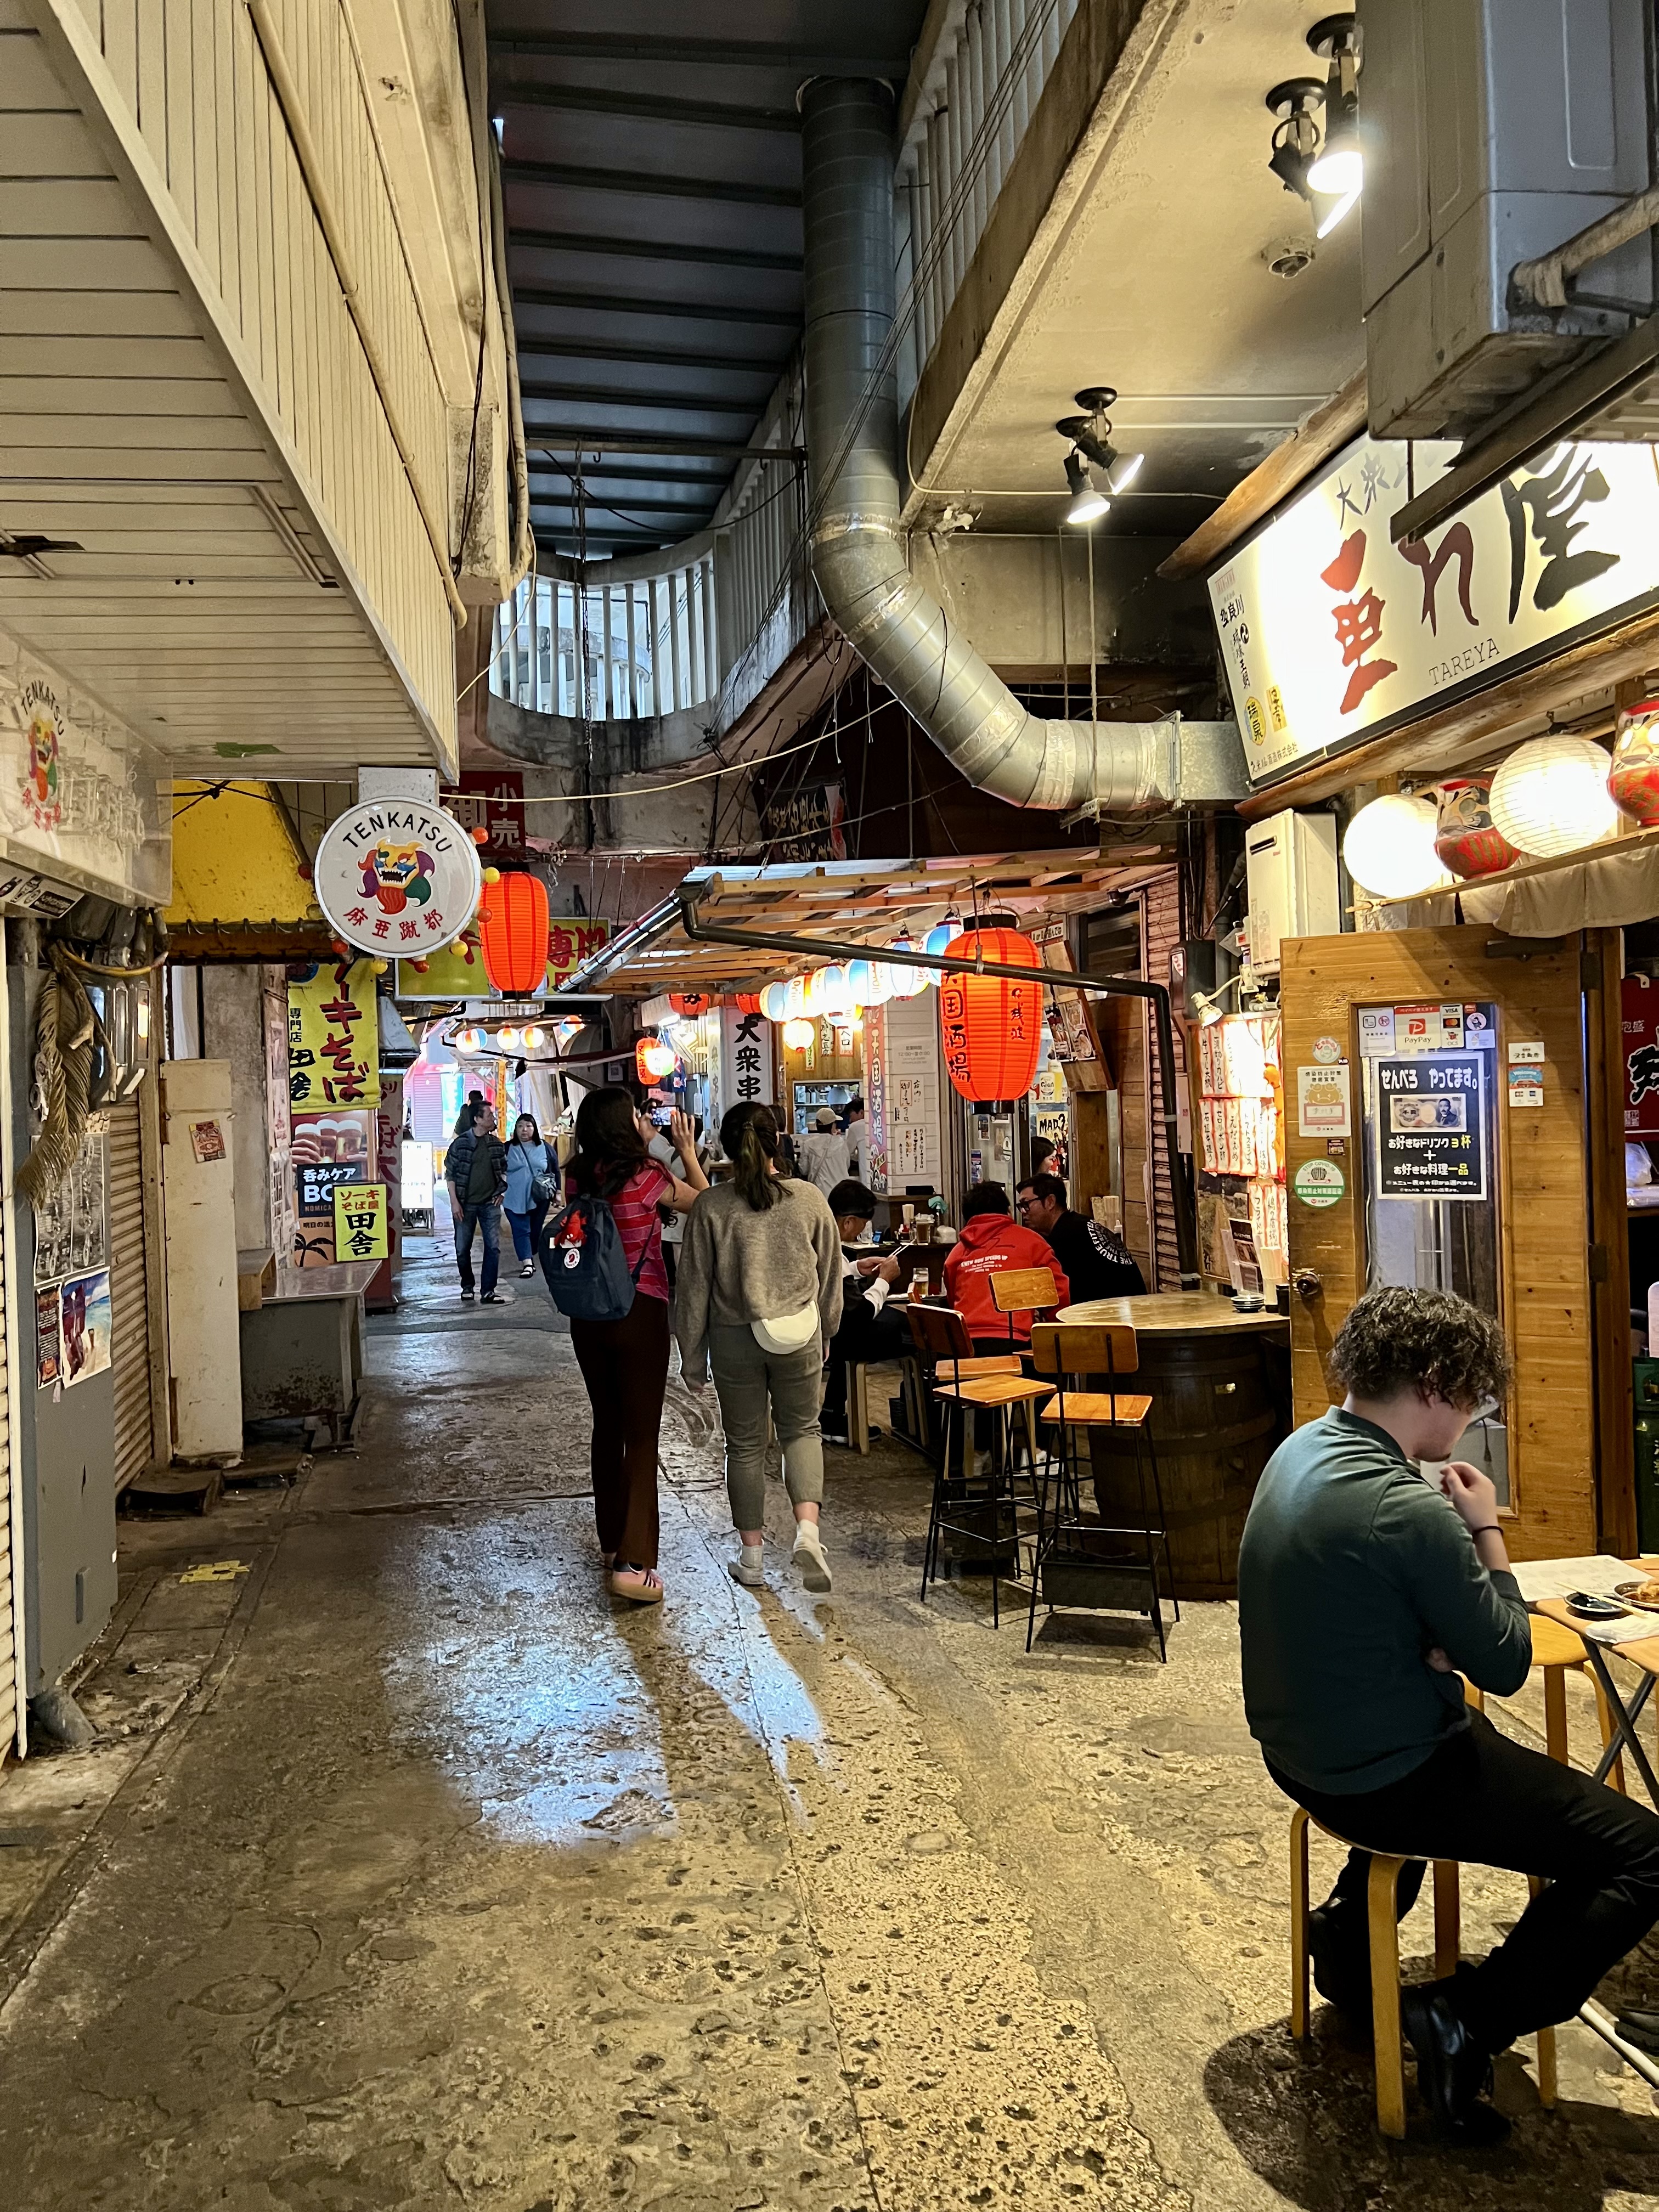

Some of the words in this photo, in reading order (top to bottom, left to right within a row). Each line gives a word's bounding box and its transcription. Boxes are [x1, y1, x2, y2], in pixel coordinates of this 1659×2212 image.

[1429, 637, 1500, 686] TAREYA
[20, 680, 65, 736] TENKATSU
[342, 811, 453, 853] TENKATSU
[491, 782, 522, 849] 小売
[290, 1007, 302, 1043] 専門店
[1404, 1036, 1432, 1045] PayPay
[734, 1015, 762, 1100] 大衆串
[1381, 1069, 1419, 1090] せんべろ
[1429, 1066, 1478, 1090] やってます。
[303, 1167, 356, 1183] 呑みケア
[1302, 1162, 1314, 1172] STOP
[1393, 1163, 1469, 1176] お好きな料理一品
[340, 1189, 380, 1200] ソーキ
[343, 1212, 381, 1256] 田舎
